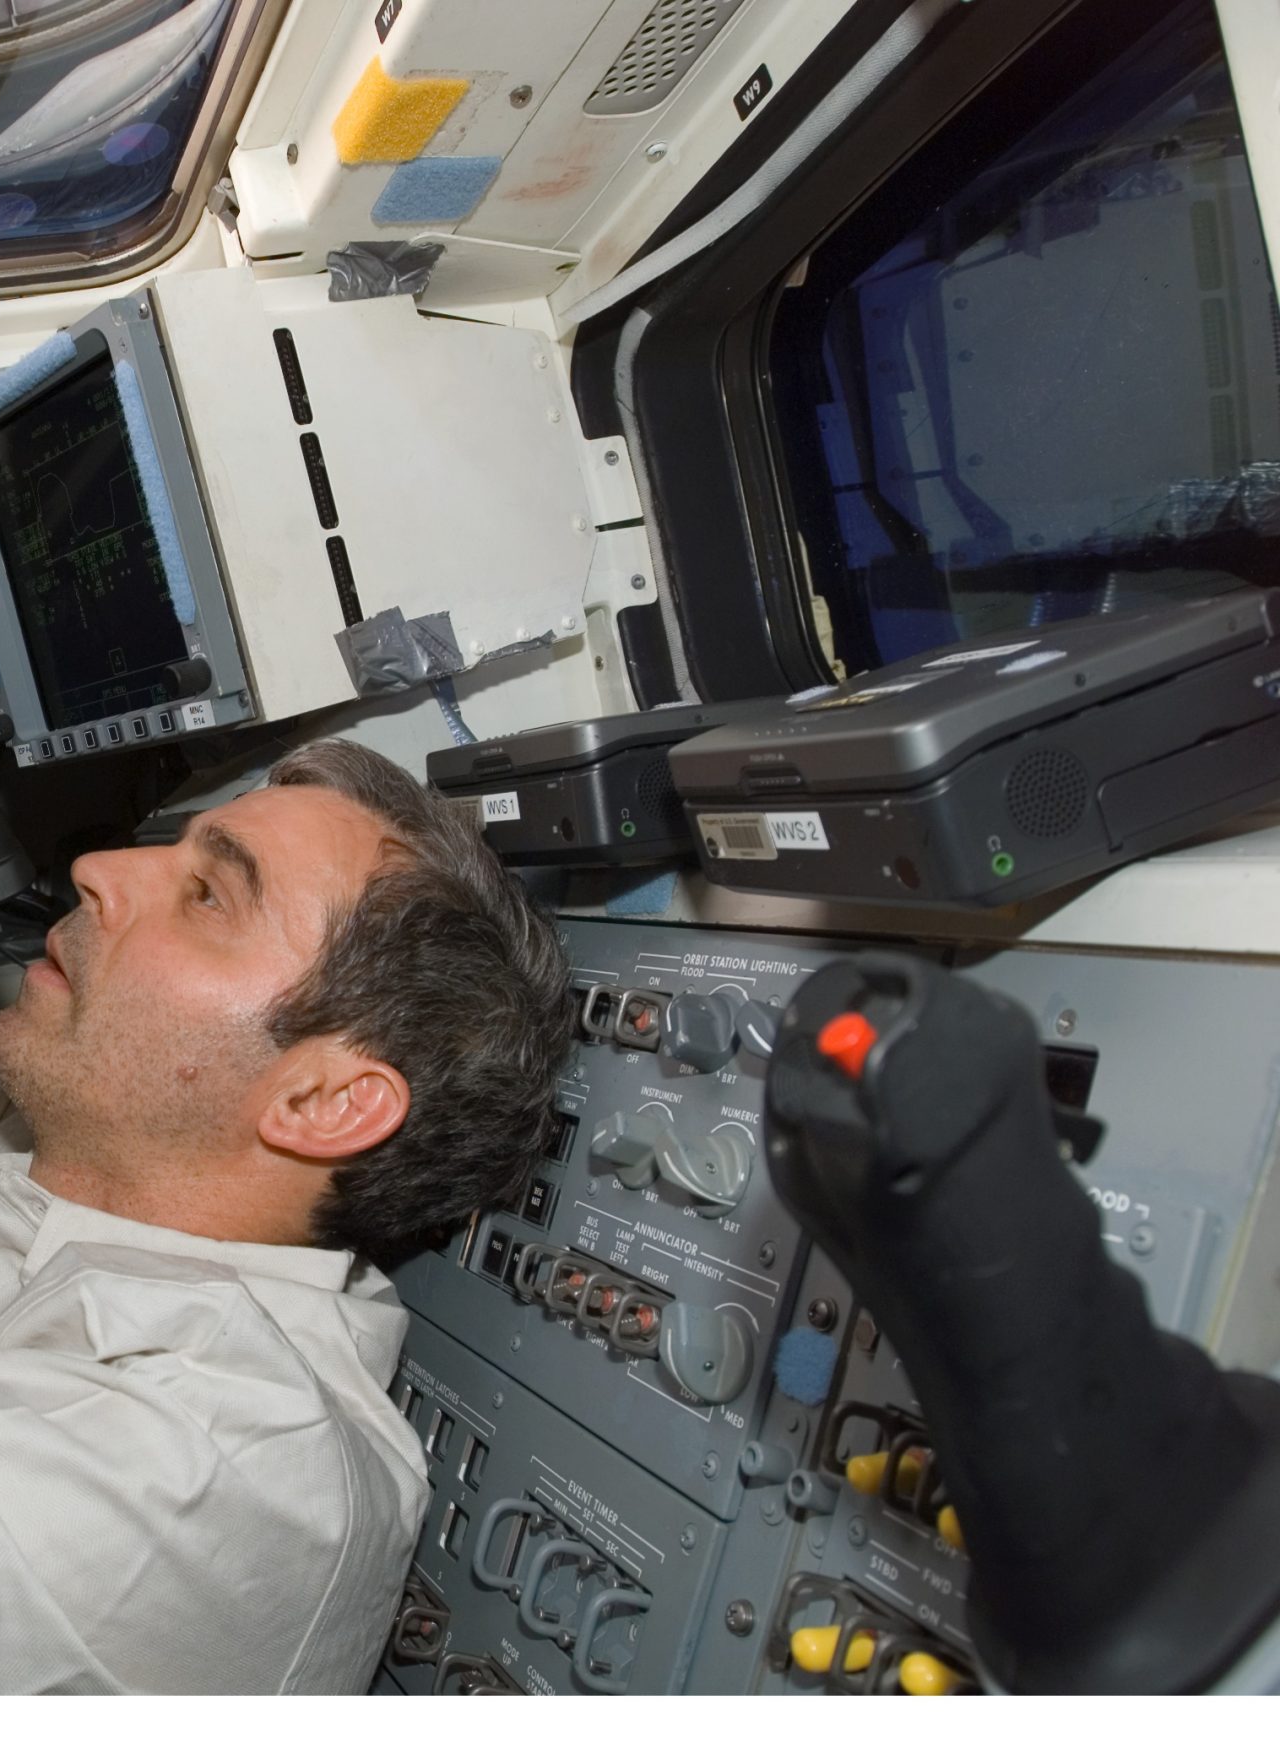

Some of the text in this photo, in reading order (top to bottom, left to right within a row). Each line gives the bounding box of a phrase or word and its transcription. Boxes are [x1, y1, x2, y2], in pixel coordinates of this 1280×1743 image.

[742, 79, 761, 106] W9
[487, 801, 509, 815] WVS
[510, 799, 515, 813] 1
[771, 821, 820, 841] WVS 2
[681, 967, 705, 978] FLOOD
[684, 953, 798, 976] ORBIT STATION LIGHTING
[648, 976, 661, 987] ON
[626, 1054, 640, 1065] OFF
[679, 1064, 694, 1075] DIM
[722, 1073, 738, 1086] BRT
[640, 1085, 684, 1104] INSTRUMENT
[564, 1100, 577, 1111] YAW
[720, 1105, 761, 1125] NUMERIC
[645, 1190, 660, 1204] BRT
[586, 1215, 599, 1228] BUS
[724, 1219, 741, 1234] BRT
[579, 1225, 600, 1241] SELECT
[616, 1228, 636, 1243] LAMP
[633, 1221, 699, 1257] ANNUNCIATOR
[577, 1236, 596, 1251] MN B
[615, 1241, 631, 1254] TEST
[609, 1251, 624, 1264] LEFT
[641, 1264, 670, 1285] BRIGHT
[683, 1257, 725, 1282] INTENSITY
[568, 1320, 574, 1331] C
[625, 1352, 639, 1368] VAR
[406, 1358, 460, 1405] RETENTION LATCHES
[420, 1382, 434, 1398] LATCH
[723, 1410, 744, 1429] MED
[553, 1499, 568, 1516] MIN
[568, 1480, 619, 1526] EVENT TIMER
[582, 1508, 595, 1523] SET
[605, 1540, 620, 1557] SEC
[869, 1555, 899, 1581] STBD
[922, 1568, 952, 1595] FWD
[918, 1604, 941, 1626] ON
[501, 1638, 521, 1662] MODE
[502, 1653, 512, 1666] UP
